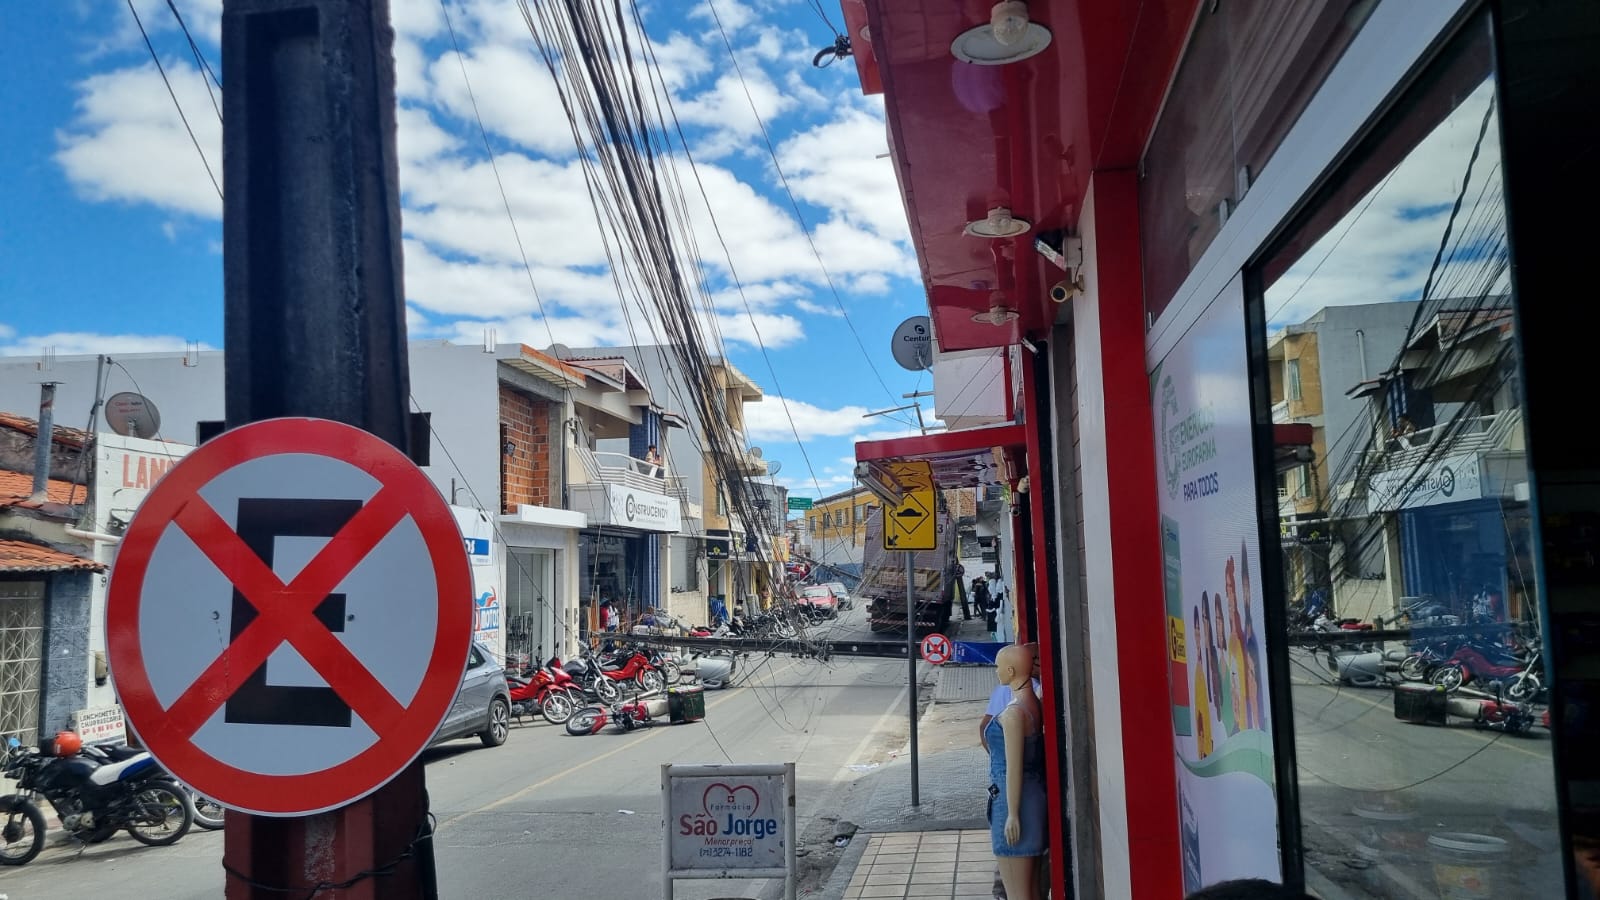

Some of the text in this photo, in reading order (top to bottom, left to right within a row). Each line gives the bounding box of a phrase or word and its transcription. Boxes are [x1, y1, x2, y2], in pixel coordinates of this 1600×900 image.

[123, 454, 175, 489] LAN
[1183, 472, 1219, 502] PARA TODOS
[626, 493, 668, 522] CONSTRUCENDY
[680, 813, 777, 839] São Jorge
